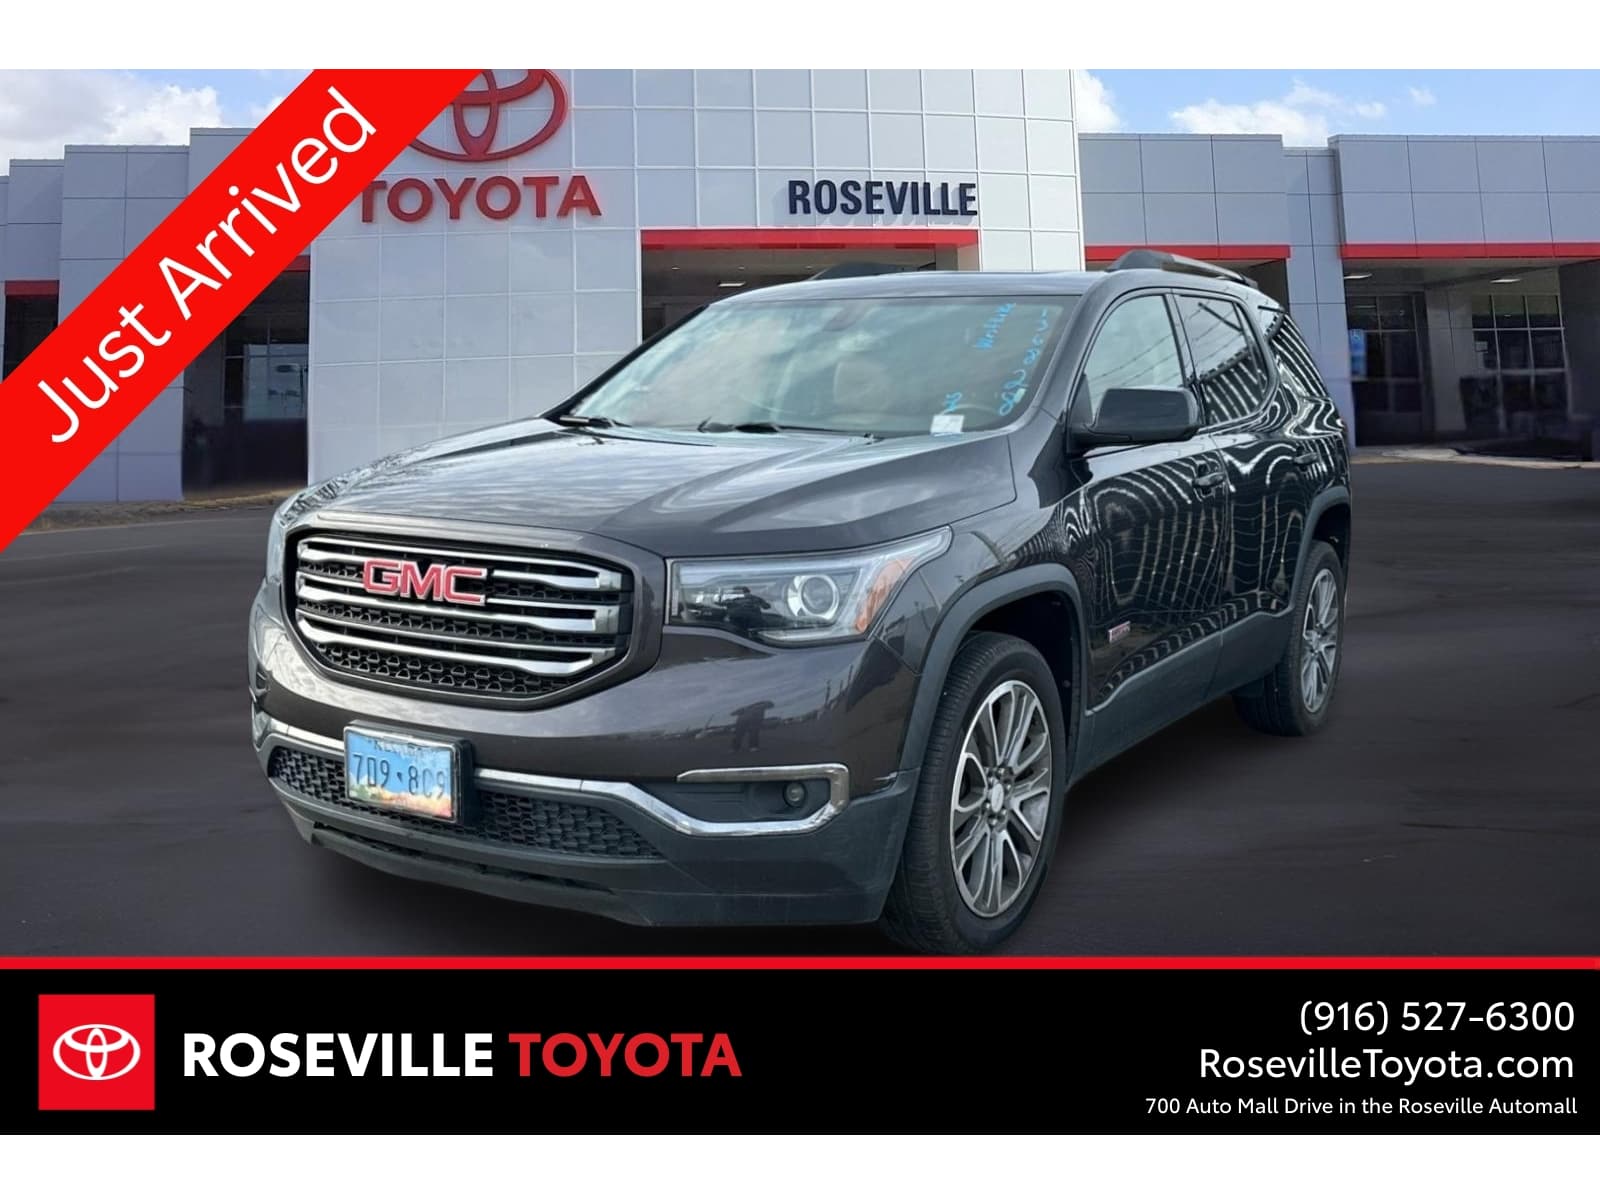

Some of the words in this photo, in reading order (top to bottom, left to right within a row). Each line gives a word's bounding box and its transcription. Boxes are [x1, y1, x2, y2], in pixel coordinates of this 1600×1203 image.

[361, 175, 602, 223] TOYOTA
[788, 179, 978, 216] ROSEVILLE
[363, 557, 487, 606] GMC
